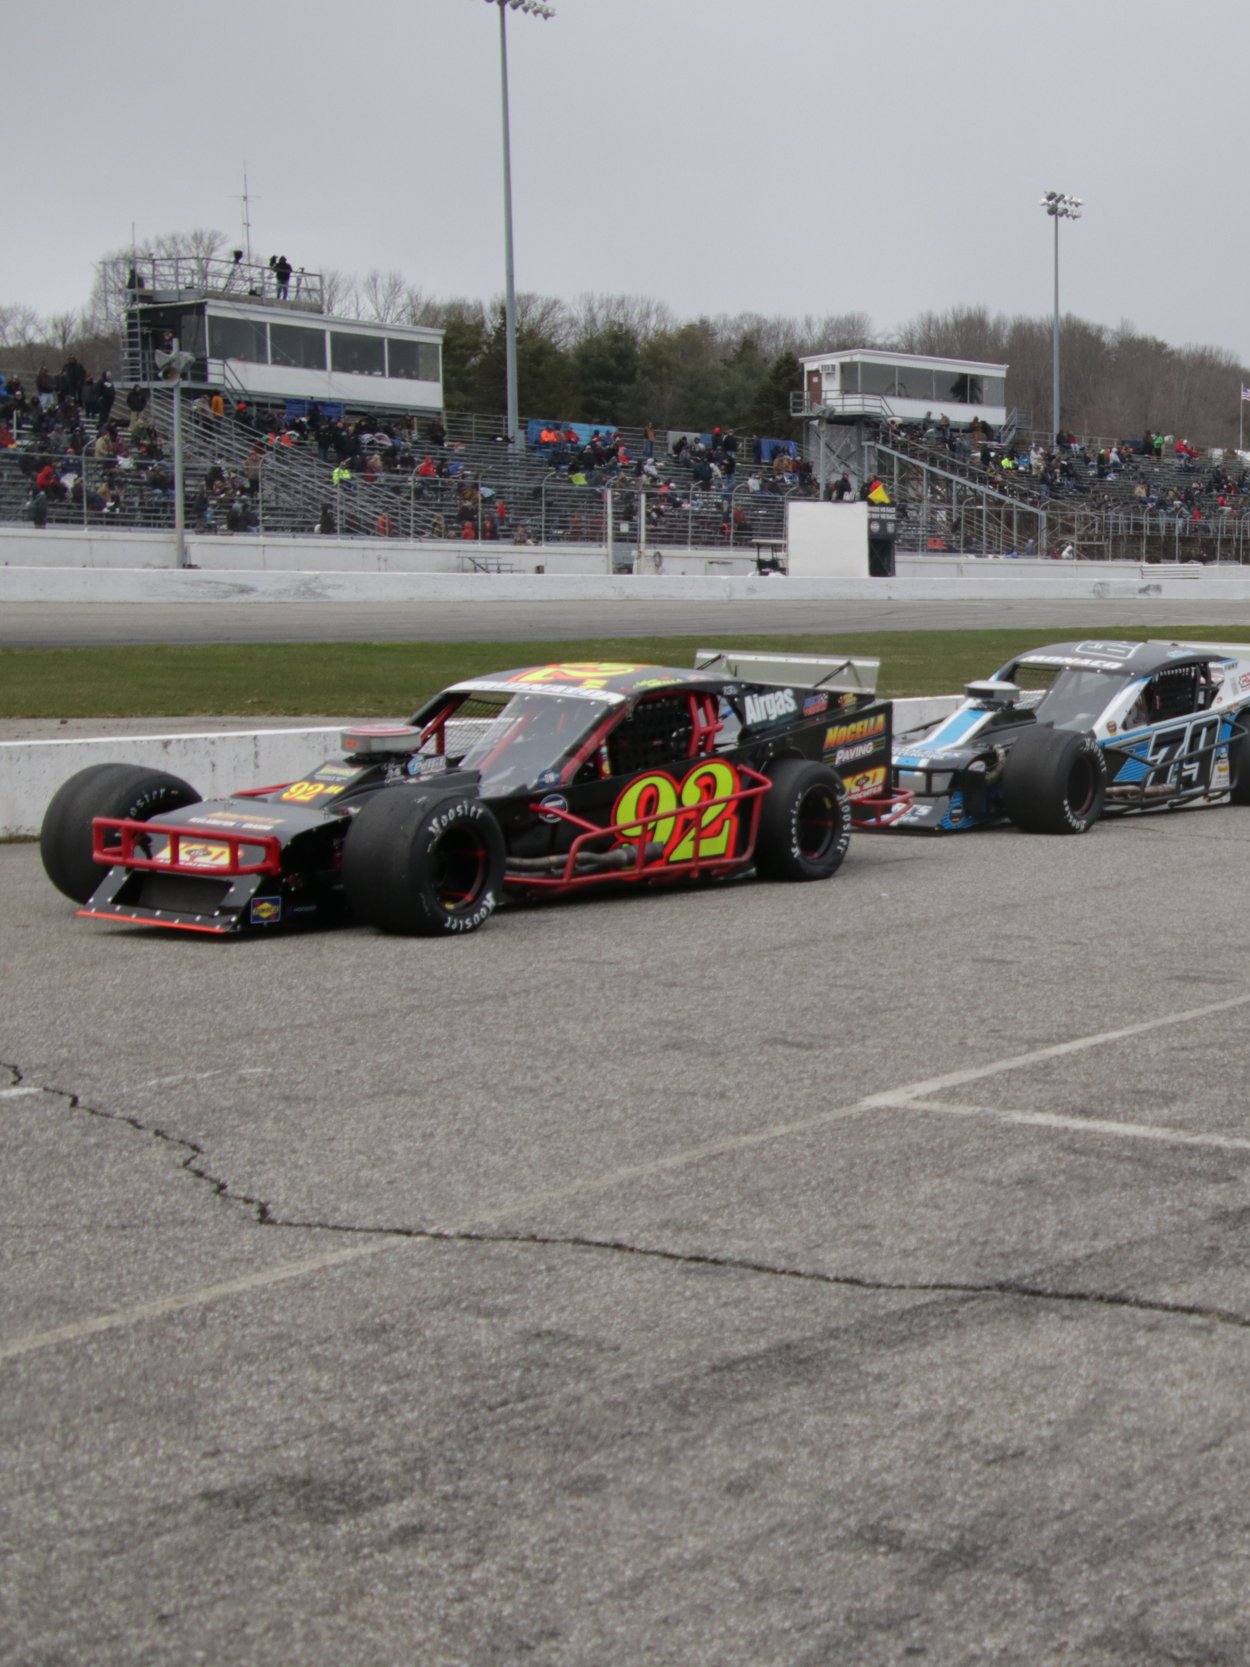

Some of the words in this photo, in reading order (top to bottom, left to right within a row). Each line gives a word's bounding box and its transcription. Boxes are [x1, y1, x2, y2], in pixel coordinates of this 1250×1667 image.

[1021, 655, 1124, 669] MONACO
[744, 688, 797, 725] Airgas
[823, 713, 886, 749] NOCELLA
[835, 742, 874, 766] PAVING
[281, 780, 325, 802] 92
[610, 758, 740, 879] 92
